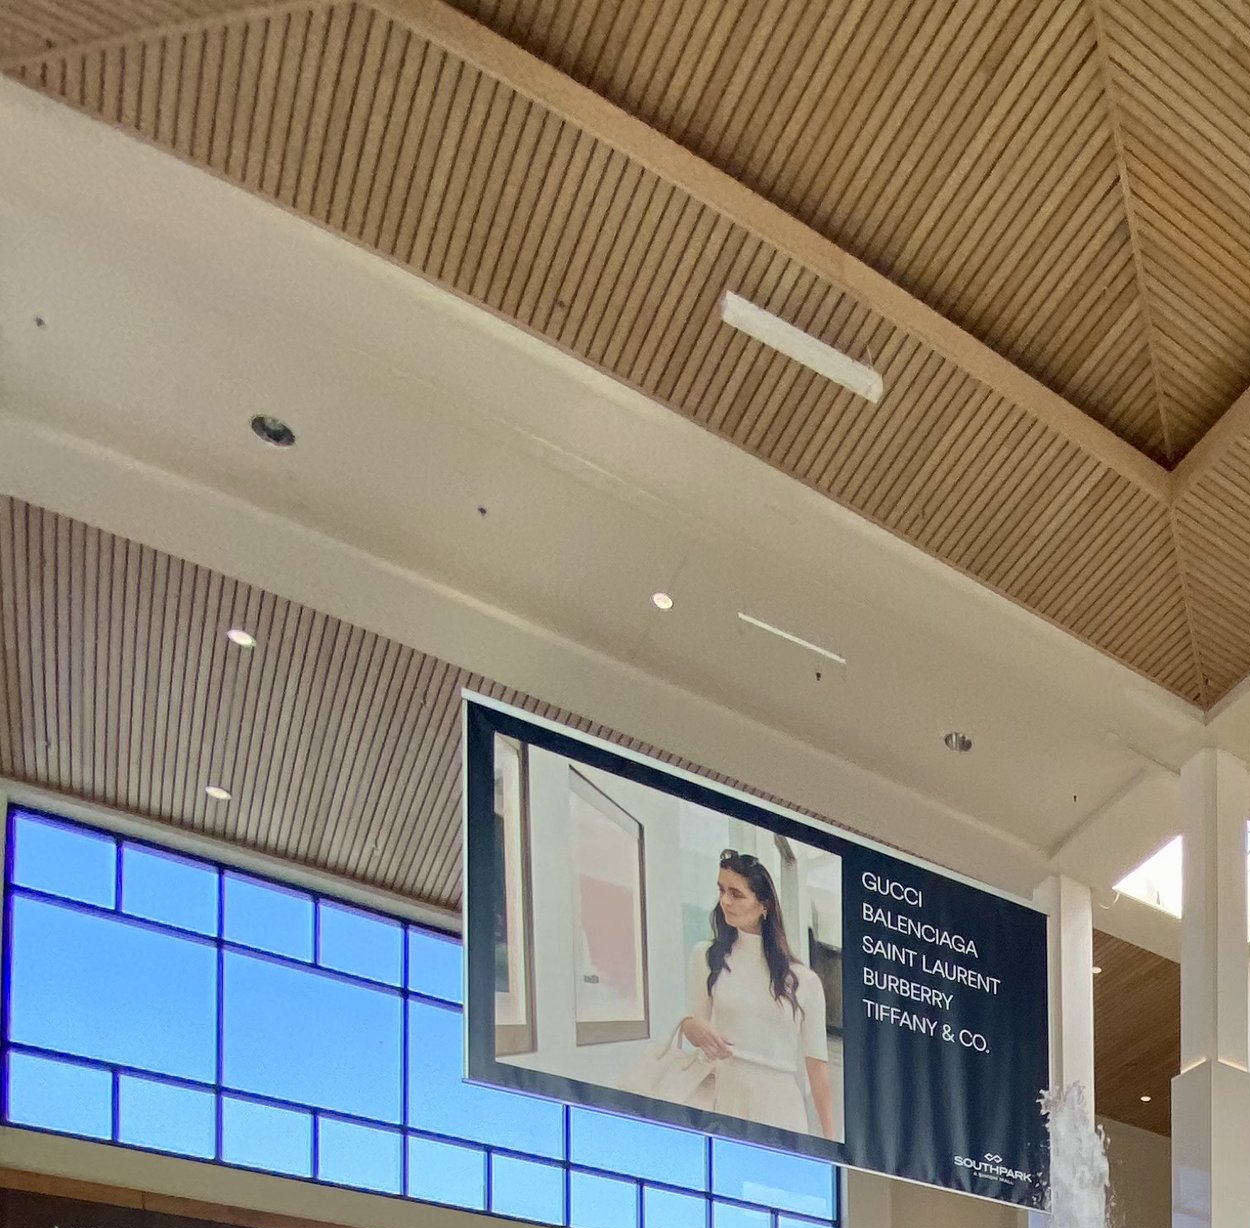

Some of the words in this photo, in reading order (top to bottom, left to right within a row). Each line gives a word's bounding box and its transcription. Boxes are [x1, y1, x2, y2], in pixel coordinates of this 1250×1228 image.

[861, 871, 923, 908] GUCCI
[862, 902, 979, 958] BALENCIAGA
[862, 935, 918, 968] SAINT
[922, 954, 1001, 995] LAURENT
[863, 967, 954, 1011] BURBERRY
[862, 998, 938, 1037] TIFFANY
[941, 1024, 955, 1043] &
[959, 1029, 990, 1054] CO.
[954, 1155, 1033, 1183] SOUTHPARK
